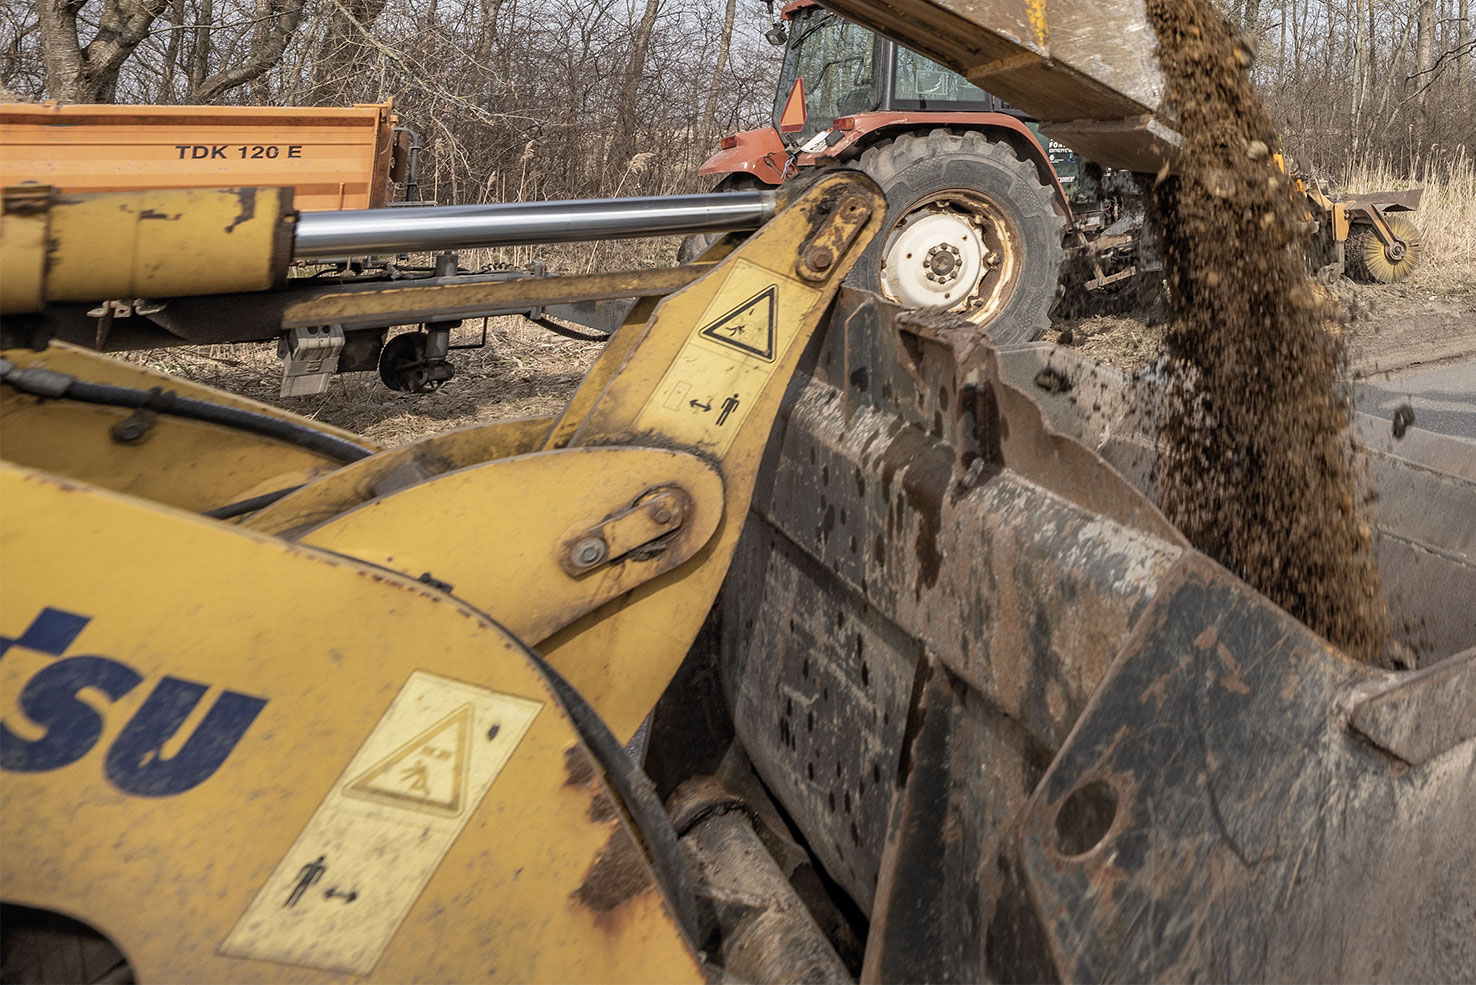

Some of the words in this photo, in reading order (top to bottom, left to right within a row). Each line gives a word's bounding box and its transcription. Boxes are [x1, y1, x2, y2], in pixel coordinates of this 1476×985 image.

[175, 145, 229, 160] TDK
[238, 145, 280, 159] 120
[287, 145, 303, 159] E
